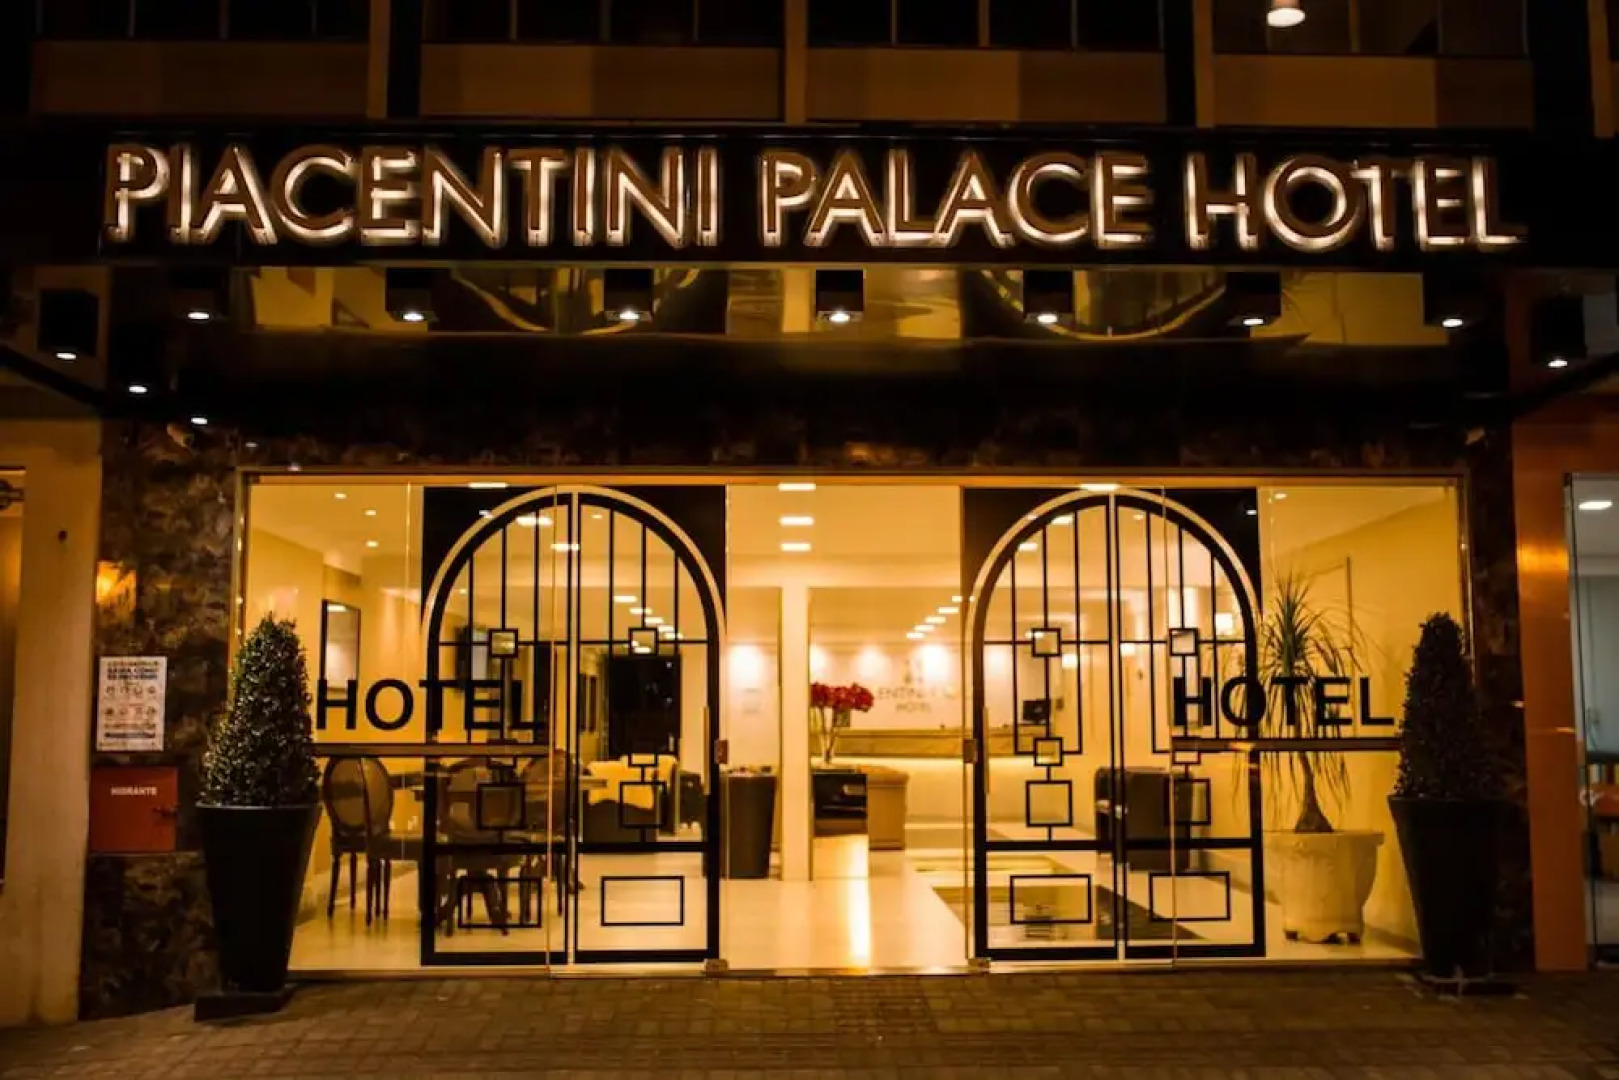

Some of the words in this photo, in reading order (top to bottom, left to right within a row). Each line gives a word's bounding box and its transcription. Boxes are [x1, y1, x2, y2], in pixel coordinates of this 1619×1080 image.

[104, 144, 719, 249] PIACENTINI
[757, 147, 1153, 250] PALACE
[1183, 151, 1525, 252] HOTEL
[316, 678, 547, 731] HOTEL
[1173, 676, 1395, 727] HOTEL
